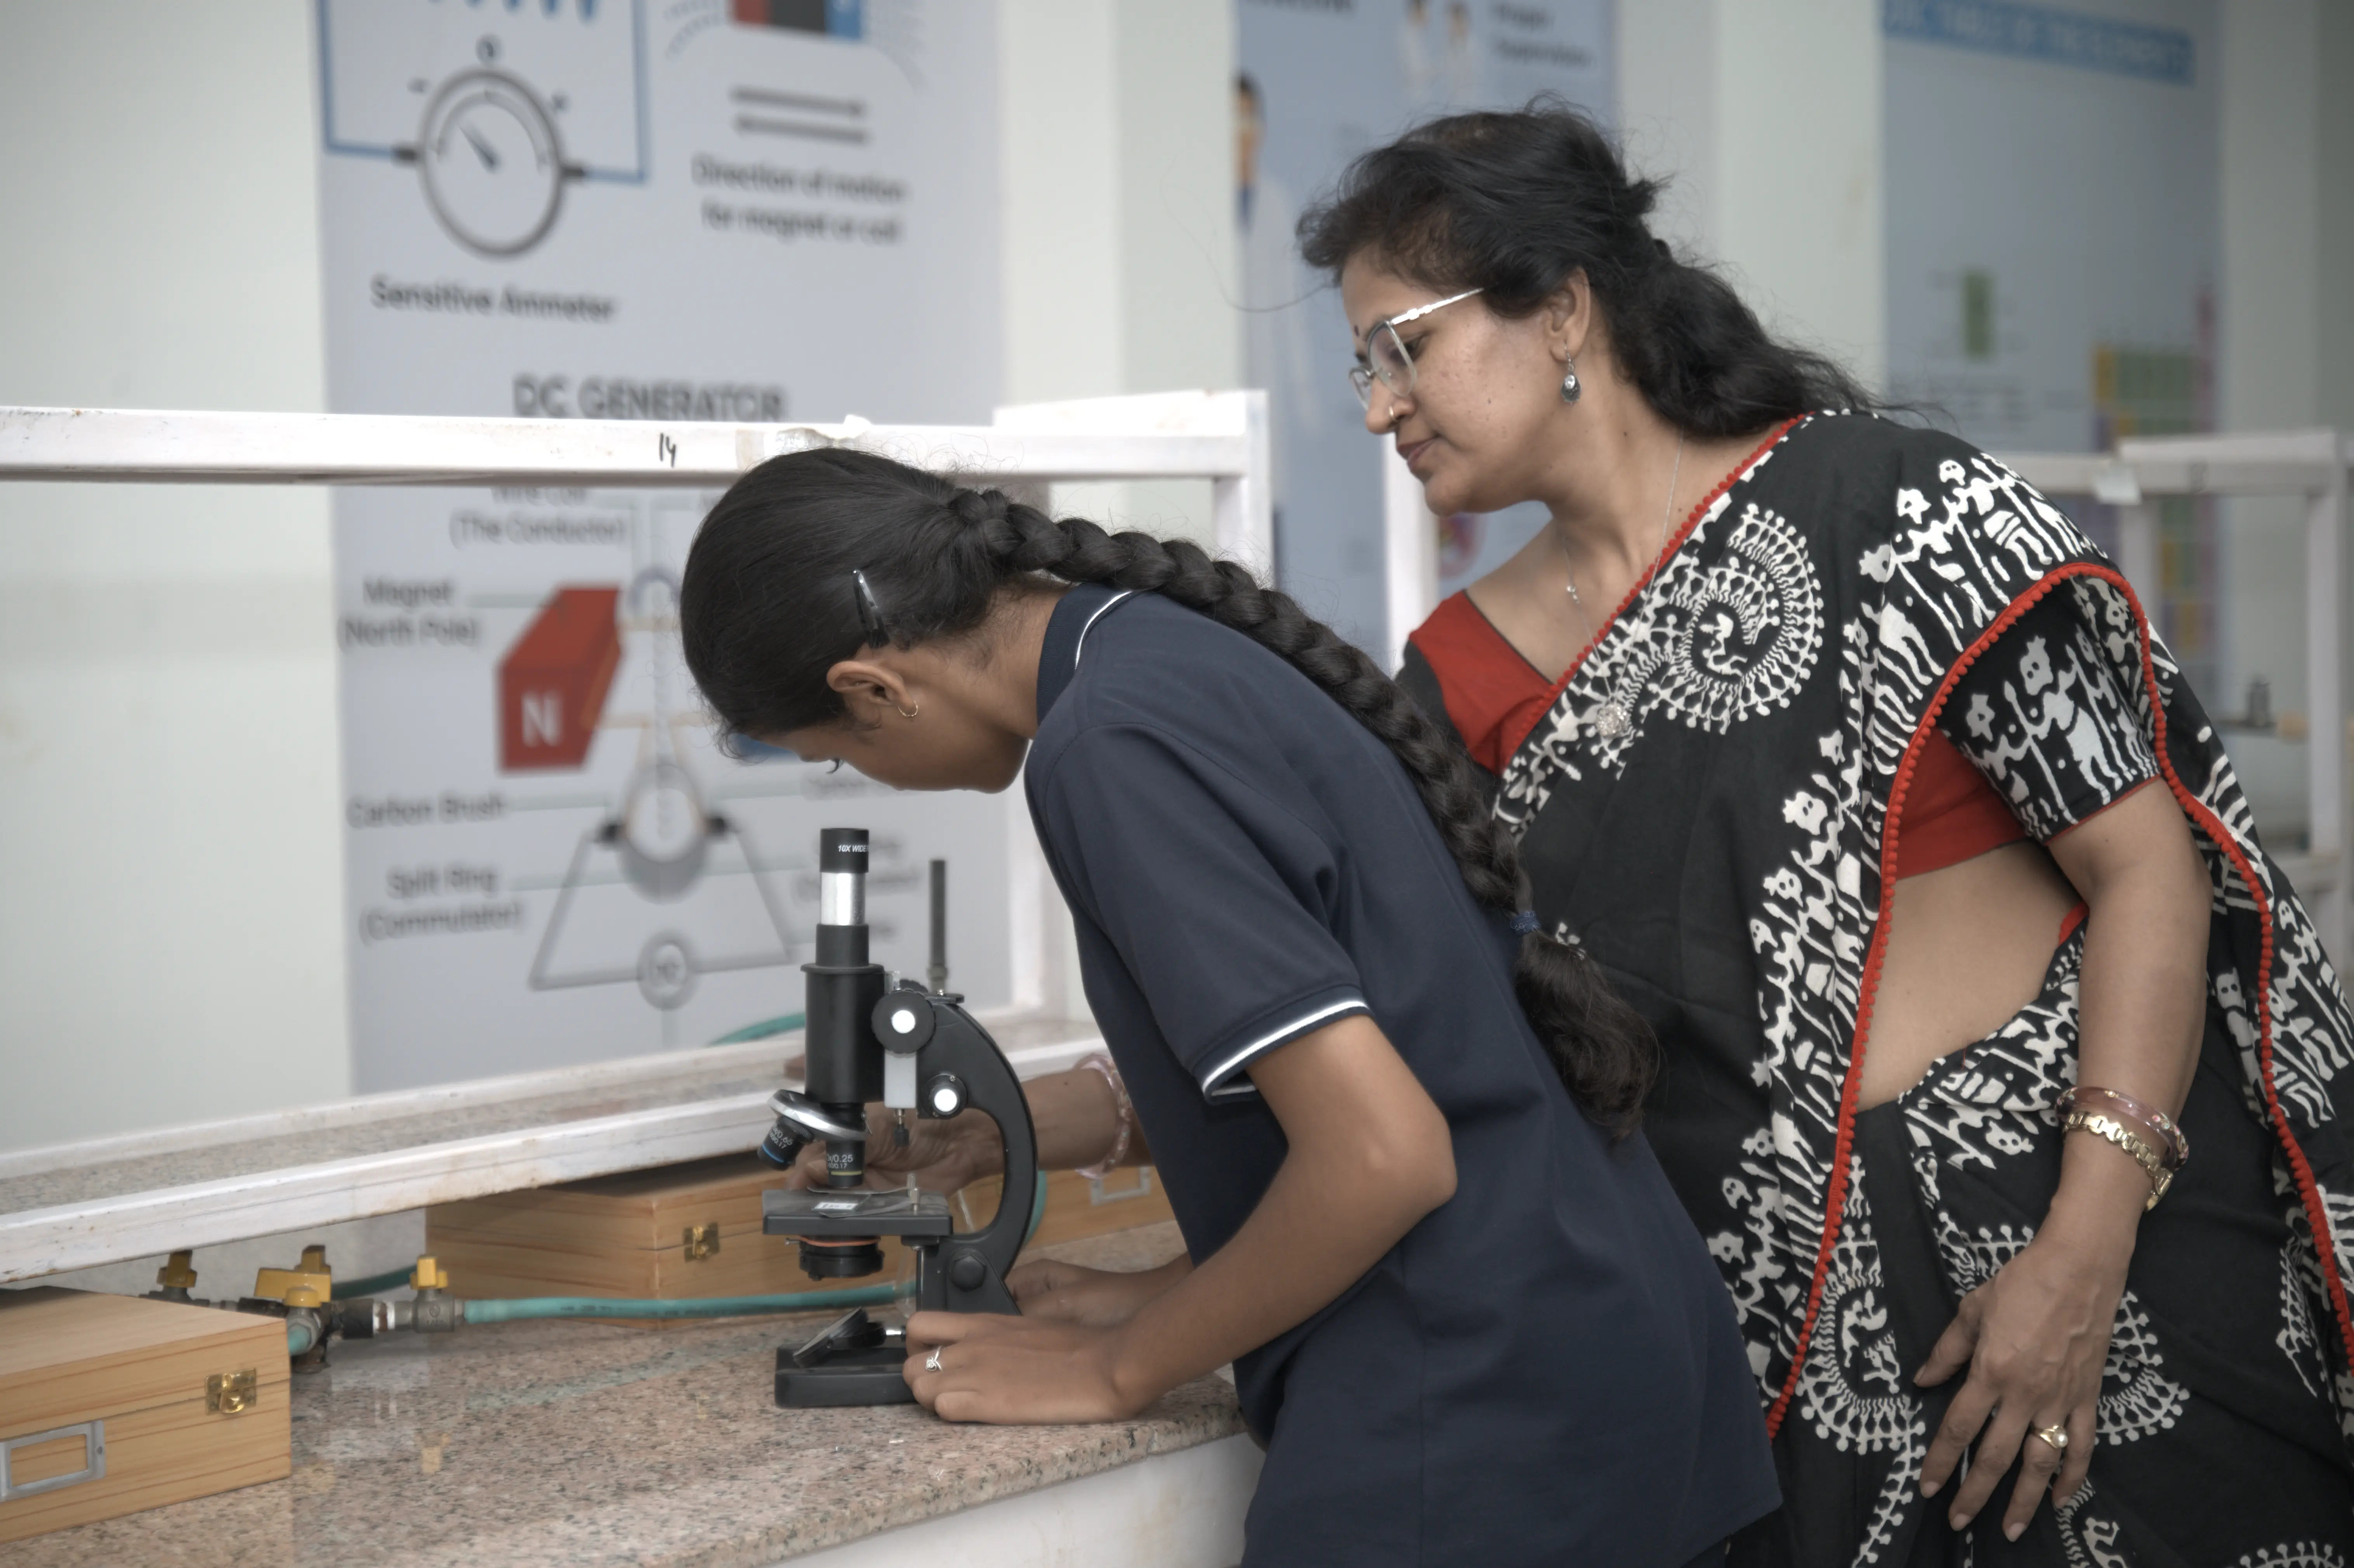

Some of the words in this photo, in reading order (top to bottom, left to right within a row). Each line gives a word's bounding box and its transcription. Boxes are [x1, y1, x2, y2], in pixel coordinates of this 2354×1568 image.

[692, 153, 796, 193] Direction
[800, 165, 826, 198] of
[829, 173, 909, 203] motion
[701, 197, 732, 230] for
[737, 206, 827, 245] magnet
[857, 216, 904, 247] coil
[370, 273, 493, 315] Sensitive
[499, 283, 617, 324] Ammeter
[512, 373, 569, 419] DC
[578, 377, 790, 423] GENERATOR
[659, 432, 676, 468] 14
[449, 508, 502, 548] (The
[505, 510, 627, 546] Conductor)
[362, 578, 453, 613] Magnet
[338, 615, 414, 653] (North
[521, 692, 563, 747] N
[346, 796, 432, 829] Carbon
[438, 791, 507, 824] Brush
[838, 844, 851, 852] 10X
